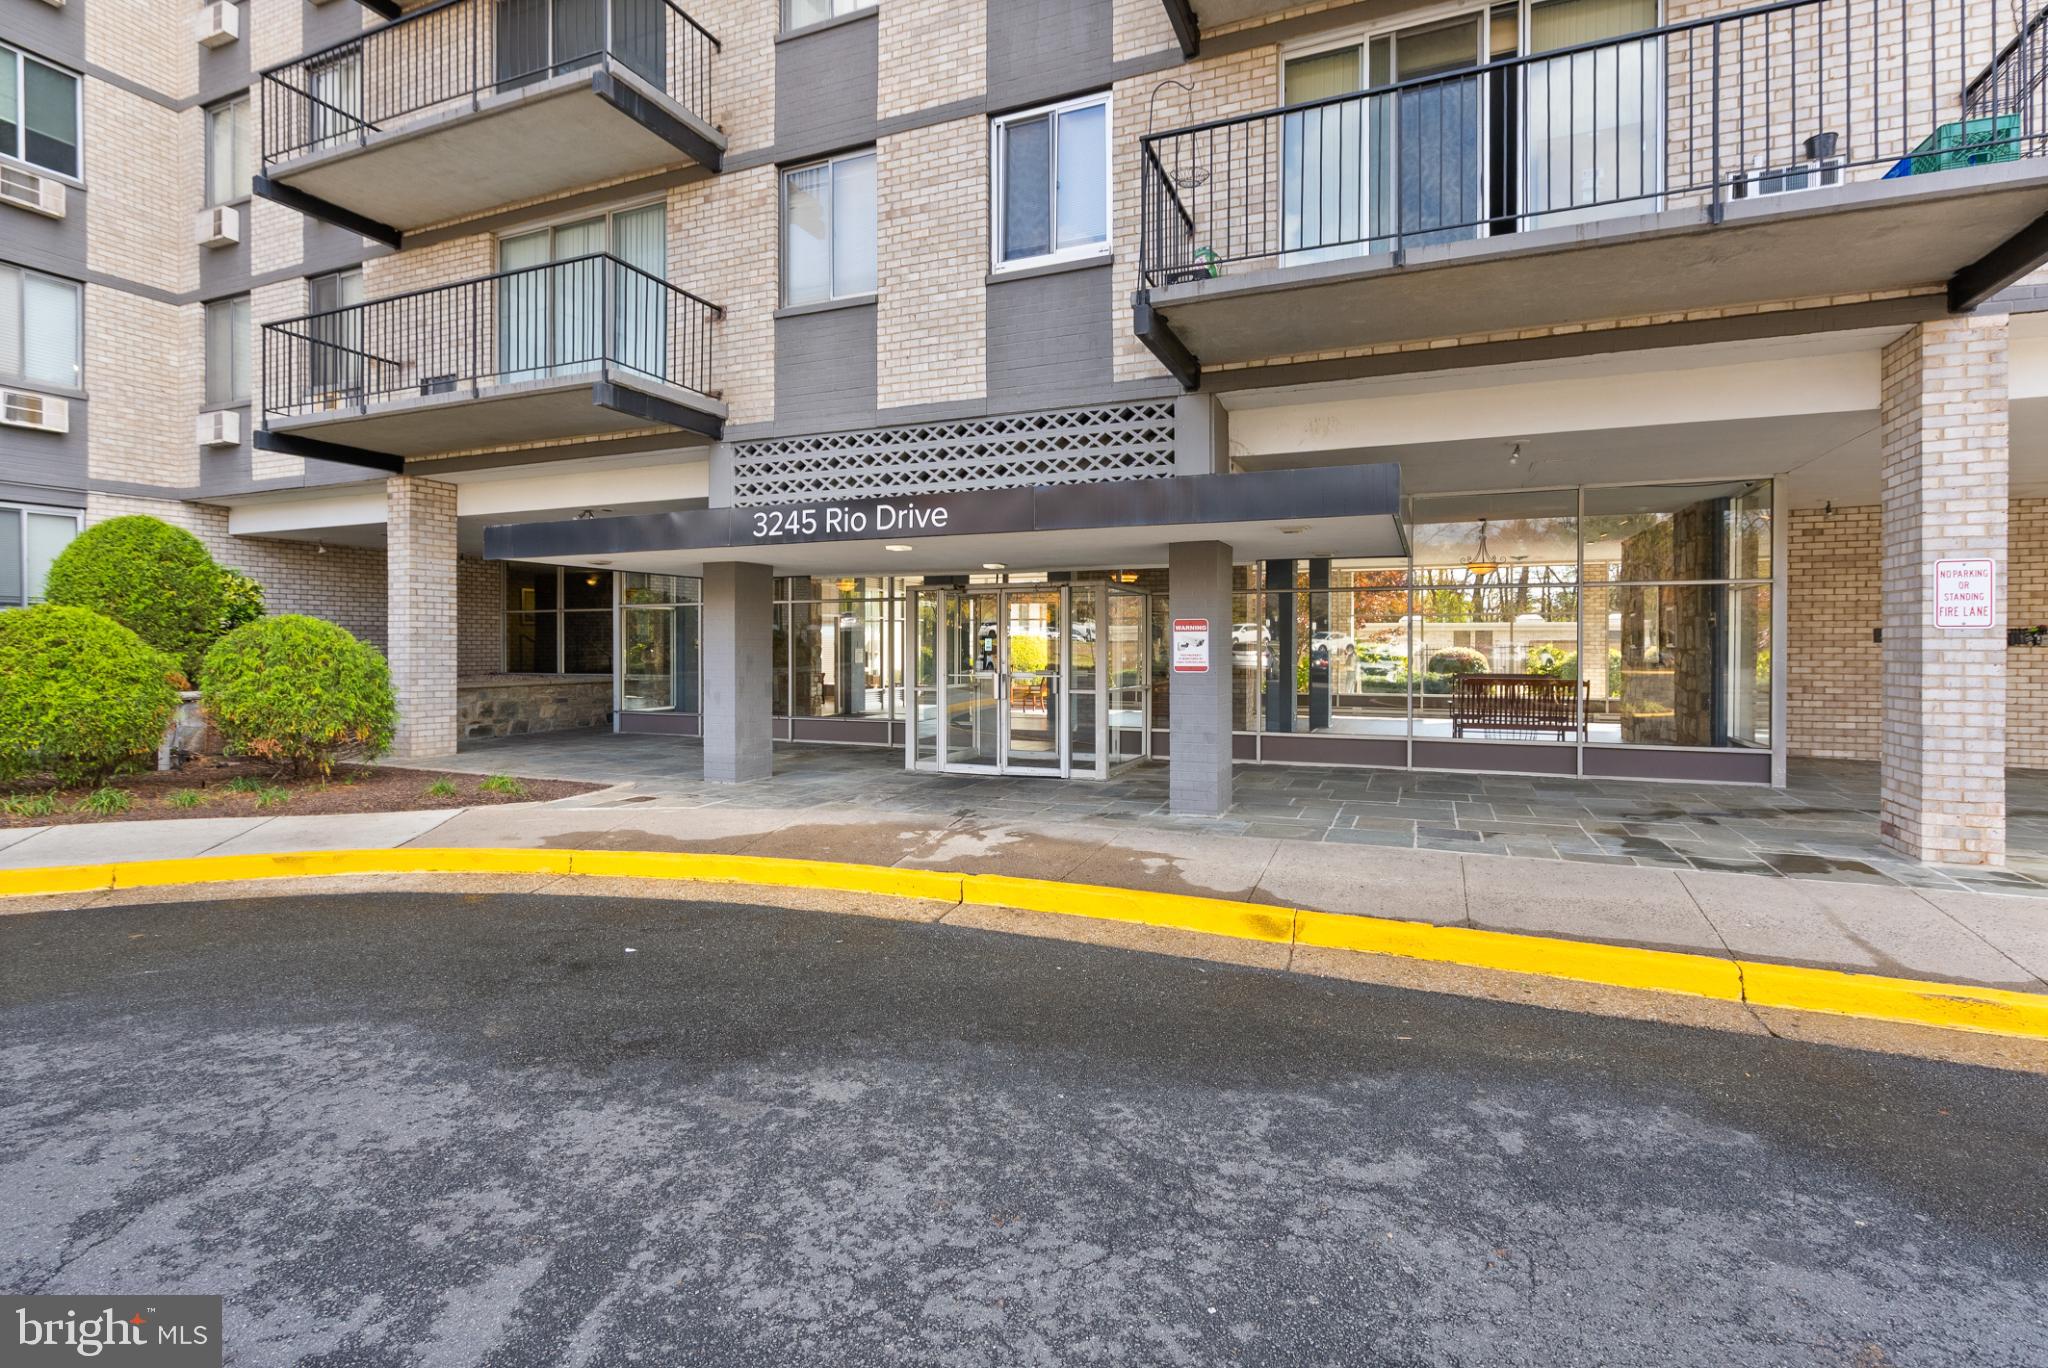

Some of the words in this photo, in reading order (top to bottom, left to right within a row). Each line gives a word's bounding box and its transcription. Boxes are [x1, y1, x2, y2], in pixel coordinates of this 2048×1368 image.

[752, 509, 817, 537] 3245
[825, 507, 867, 533] Rio
[876, 503, 948, 531] Drive
[1940, 570, 1951, 578] NO
[1953, 569, 1988, 578] PARKING
[1958, 581, 1969, 589] OR
[1944, 593, 1984, 601] STANDING
[1939, 606, 1959, 616] FIRE
[1963, 606, 1988, 616] LANE
